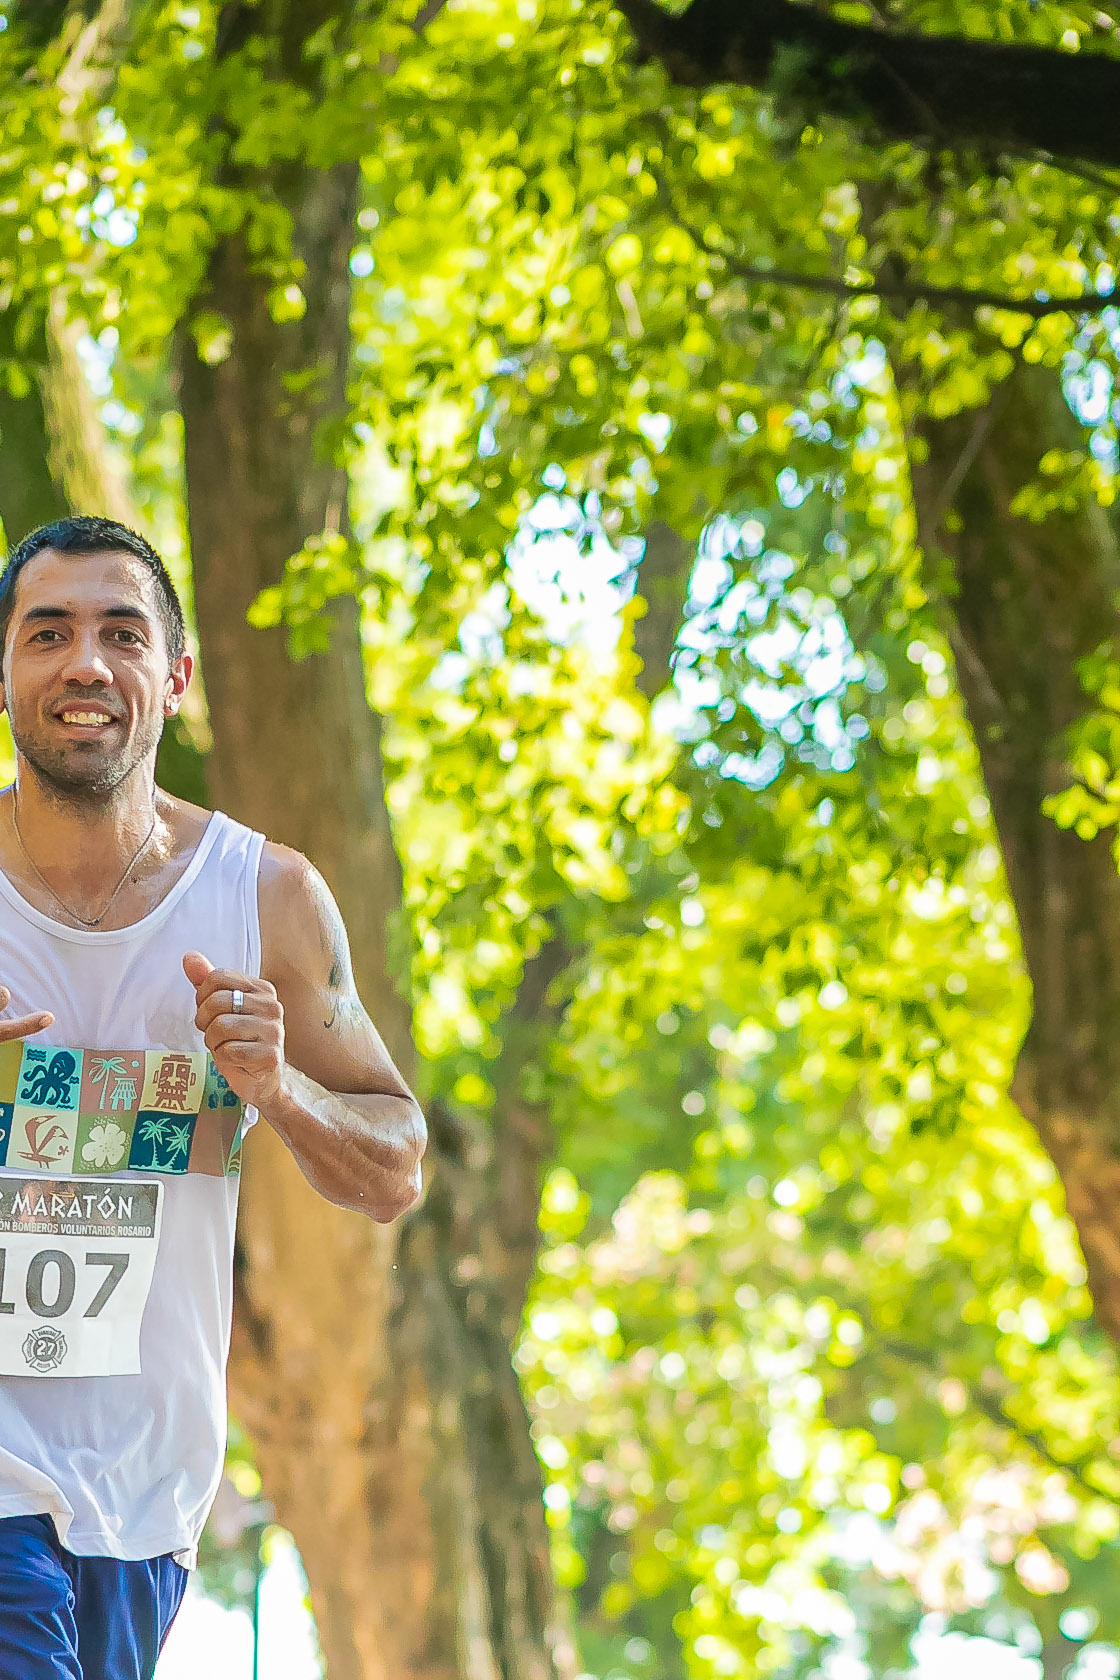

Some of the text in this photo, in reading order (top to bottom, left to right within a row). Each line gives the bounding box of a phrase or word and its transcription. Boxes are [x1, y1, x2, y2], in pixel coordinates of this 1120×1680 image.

[10, 1187, 134, 1220] MARATÓN
[12, 1221, 59, 1234] BOMBEROS
[60, 1223, 116, 1237] VOLUNTARIOS
[117, 1226, 152, 1238] ROSARIO
[36, 1339, 56, 1356] 27
